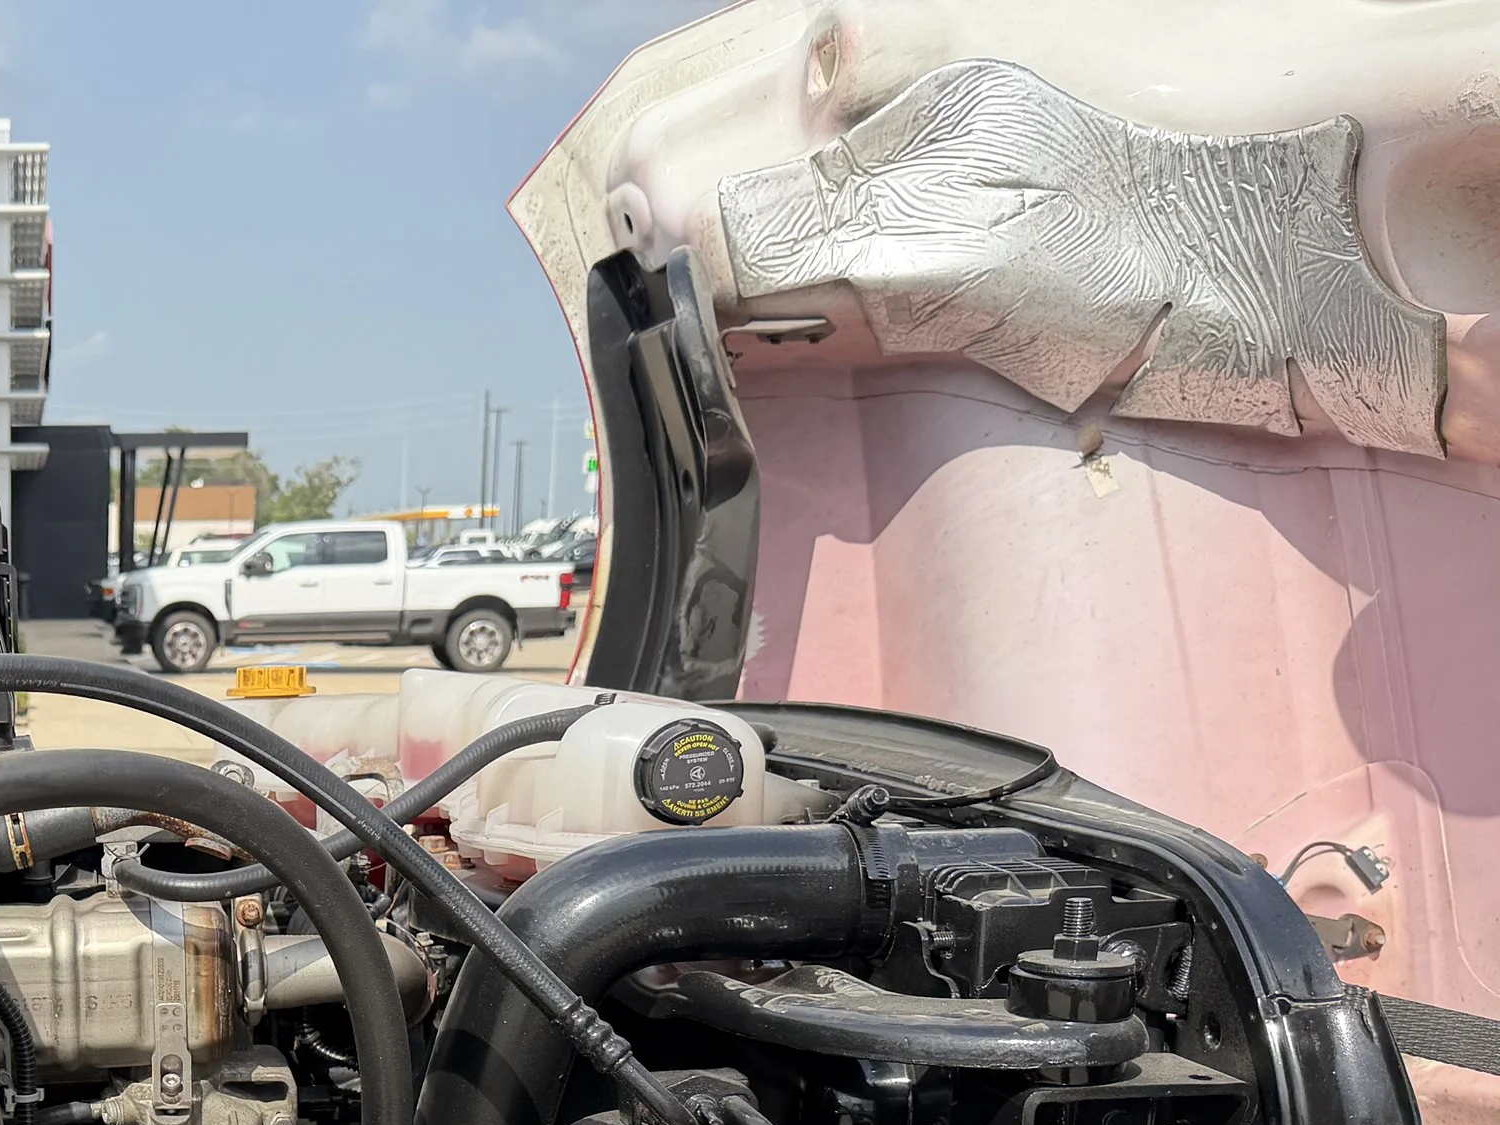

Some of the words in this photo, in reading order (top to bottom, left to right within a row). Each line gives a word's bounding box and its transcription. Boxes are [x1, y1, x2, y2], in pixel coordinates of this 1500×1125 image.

[680, 734, 714, 745] CAUTION
[674, 744, 692, 758] NEVER
[691, 741, 708, 749] OPEN
[708, 743, 720, 752] HOT
[679, 750, 715, 760] PRESSURIZED
